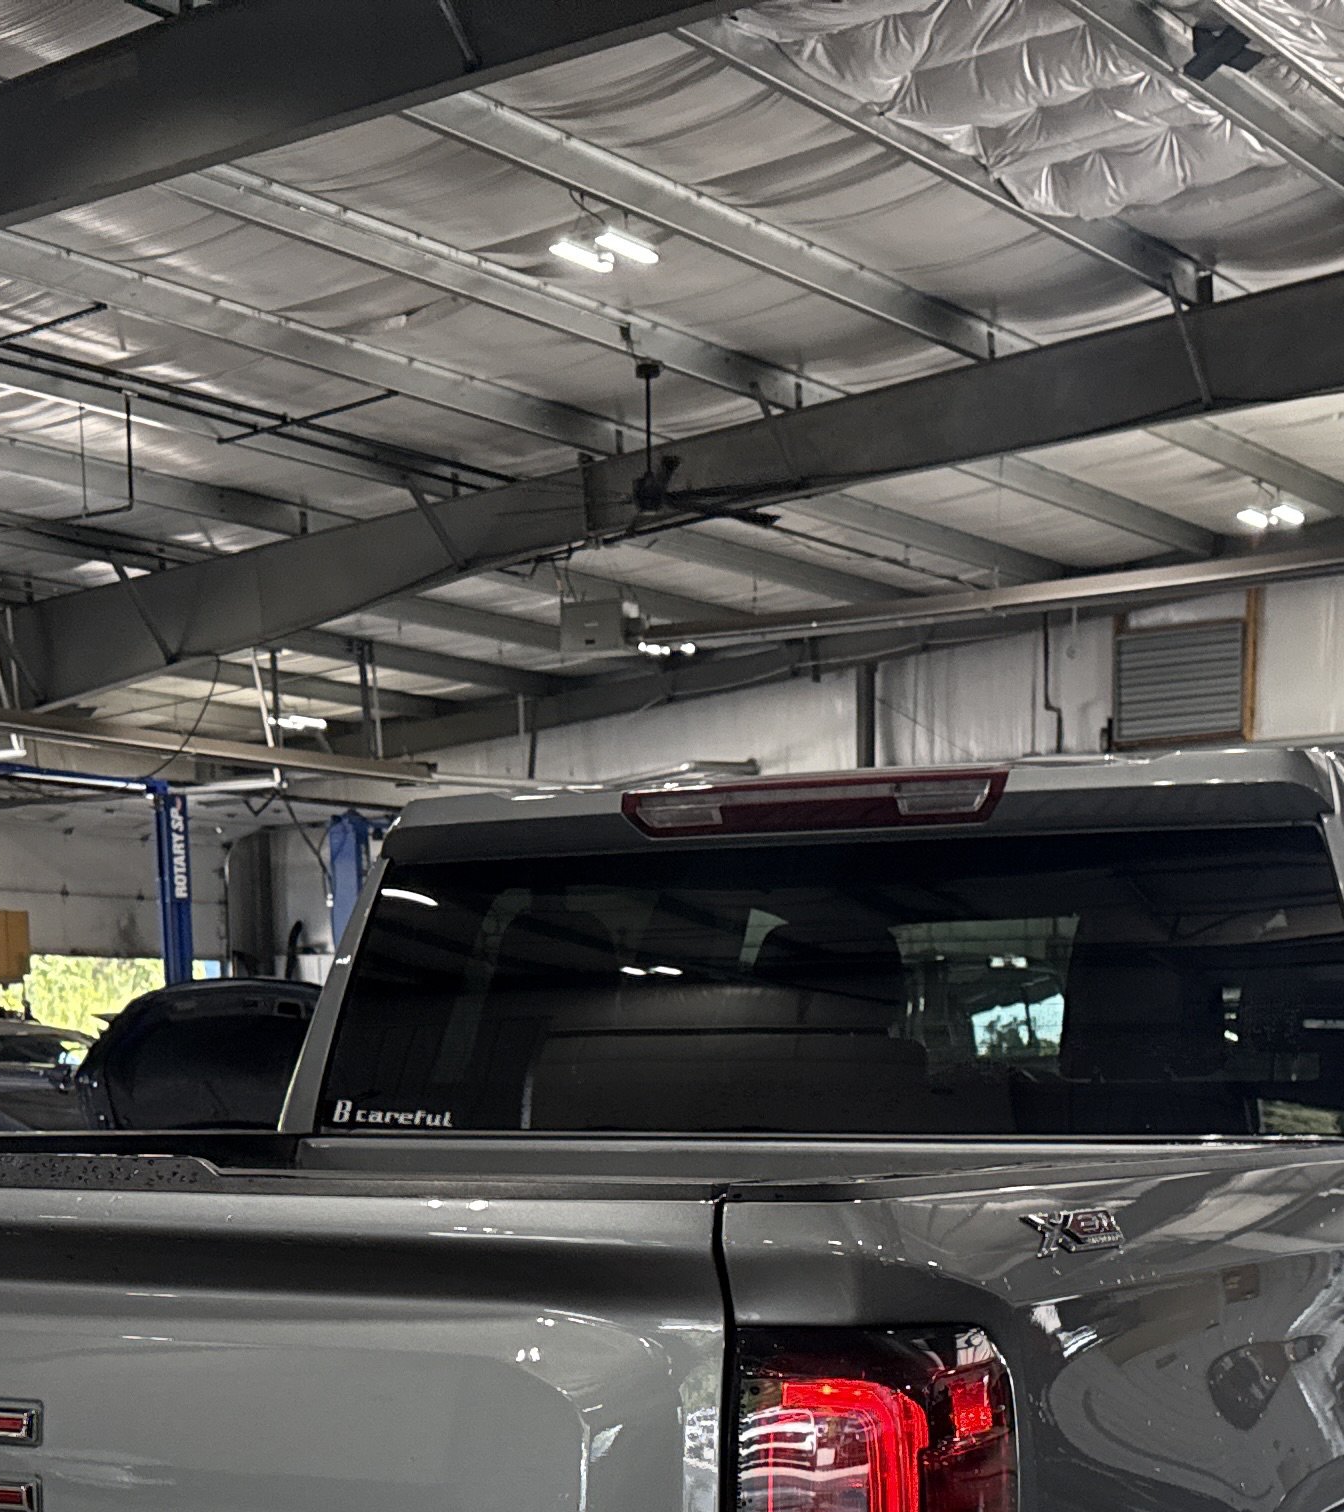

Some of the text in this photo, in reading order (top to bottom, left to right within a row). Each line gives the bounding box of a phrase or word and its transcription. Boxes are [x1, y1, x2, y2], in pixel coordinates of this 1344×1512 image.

[172, 832, 188, 898] ROTARY
[332, 1099, 452, 1127] B careful
